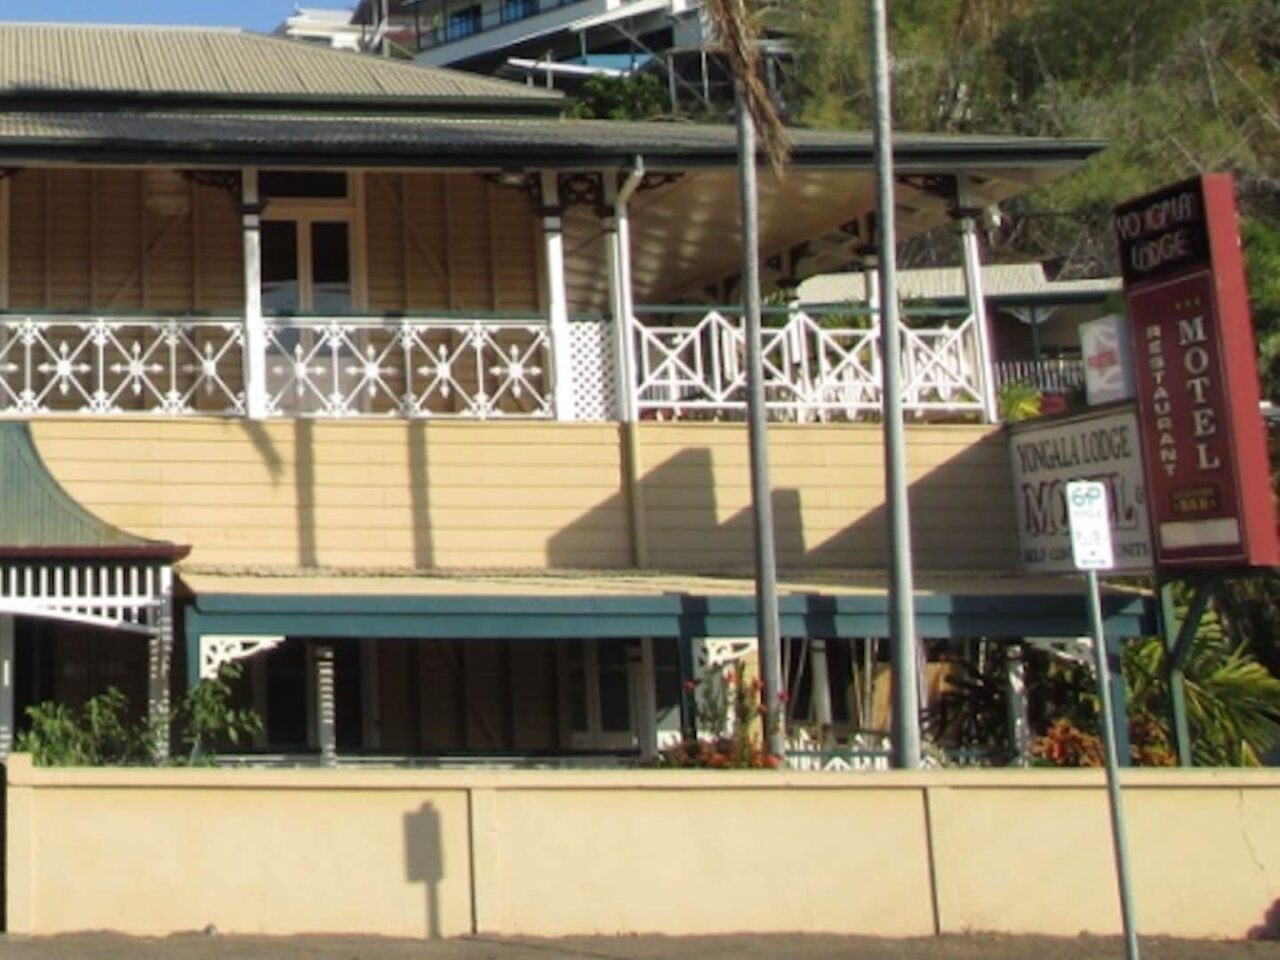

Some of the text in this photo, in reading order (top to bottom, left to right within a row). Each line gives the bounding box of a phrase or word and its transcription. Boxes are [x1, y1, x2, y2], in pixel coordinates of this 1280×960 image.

[1081, 426, 1131, 463] LODGE
[1146, 324, 1177, 477] RESTAURANT
[1176, 315, 1220, 470] MOTEL
[1021, 471, 1138, 537] MOL
